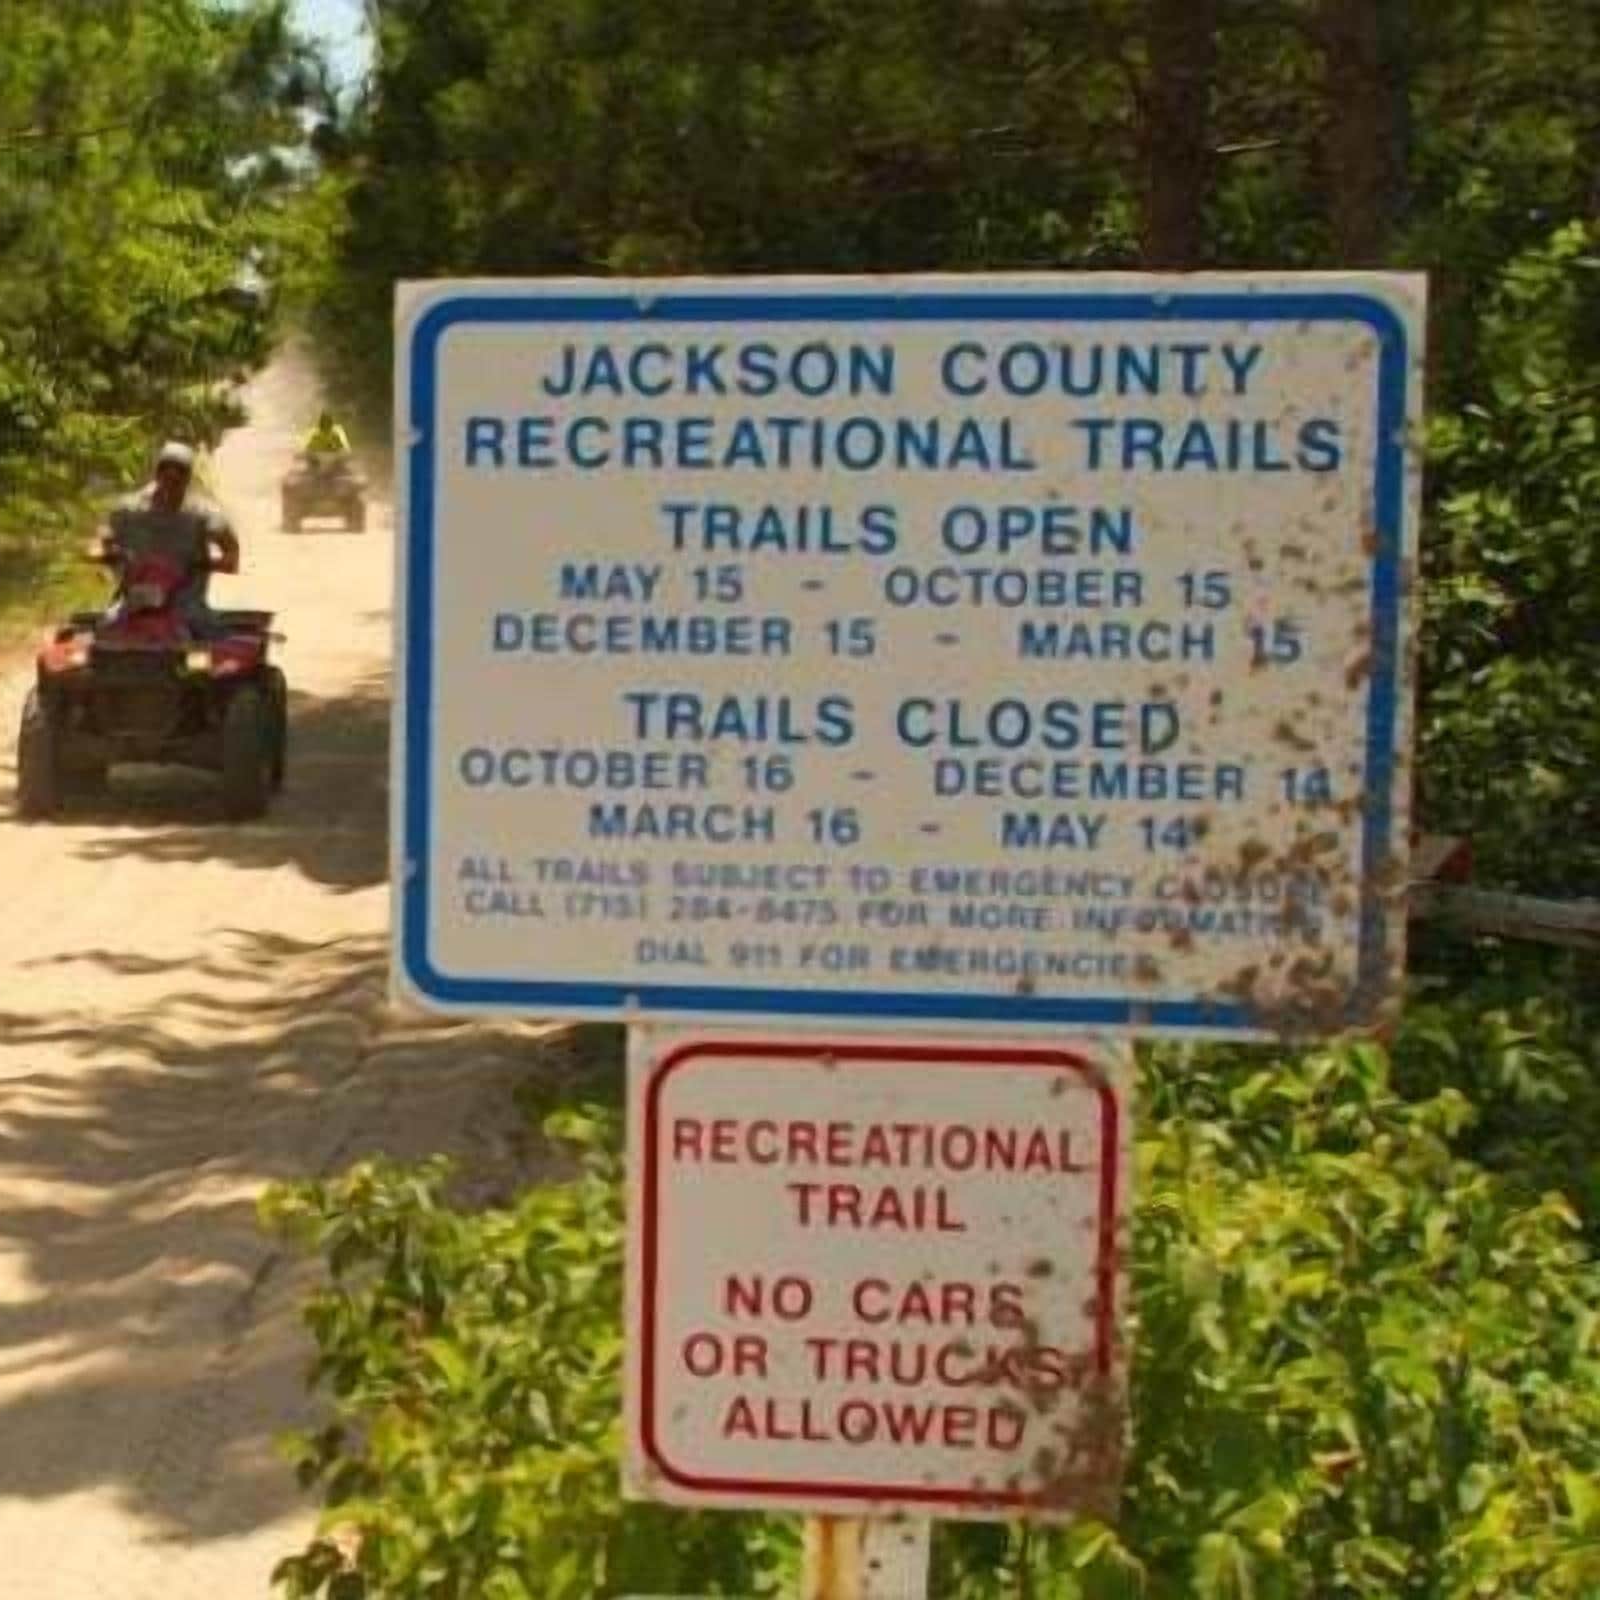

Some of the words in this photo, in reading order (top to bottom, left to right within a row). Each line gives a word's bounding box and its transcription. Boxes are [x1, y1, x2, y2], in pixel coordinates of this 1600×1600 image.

[542, 343, 894, 397] JACKSON
[941, 344, 1263, 397] COUNTY
[464, 417, 1034, 470] RECREATIONAL
[1072, 419, 1342, 472] TRAILS
[662, 504, 898, 553] TRAILS
[943, 506, 1134, 555] OPEN
[561, 565, 658, 600] MAY
[693, 567, 743, 601] 15
[885, 569, 1142, 607] OCTOBER
[1177, 571, 1231, 608] 15
[493, 615, 791, 654] DECEMBER
[827, 618, 875, 656] 15
[1019, 623, 1212, 661] MARCH
[1251, 626, 1301, 664] 15
[625, 693, 855, 746] TRAILS
[897, 700, 1182, 753] CLOSED
[460, 749, 709, 789] OCTOBER
[744, 754, 792, 791] 16
[933, 759, 1244, 801] DECEMBER
[1279, 764, 1331, 802] 14
[589, 804, 774, 843] MARCH
[809, 809, 860, 845] 16
[1001, 814, 1105, 850] MAY
[1140, 817, 1192, 853] 14
[458, 858, 511, 883] ALL
[533, 859, 649, 887] TRAILS
[671, 862, 829, 891] SUBJECT
[848, 864, 891, 892] TO
[910, 866, 1132, 898] EMERGENCY
[466, 890, 544, 917] CALL
[670, 897, 837, 926] 284-8475
[857, 901, 930, 927] FOR
[949, 904, 1050, 931] MORE
[1073, 907, 1323, 942] INFORMATIN
[636, 940, 706, 963] DIAL
[732, 943, 783, 967] 911
[800, 944, 870, 970] FOR
[673, 1120, 1089, 1173] RECREATIONAL
[787, 1183, 966, 1232] TRAIL
[726, 1275, 813, 1321] NO
[854, 1279, 1024, 1329] CARS
[684, 1334, 768, 1378] OR
[806, 1338, 1065, 1391] TRUCKS
[724, 1397, 1027, 1450] ALLOWED
